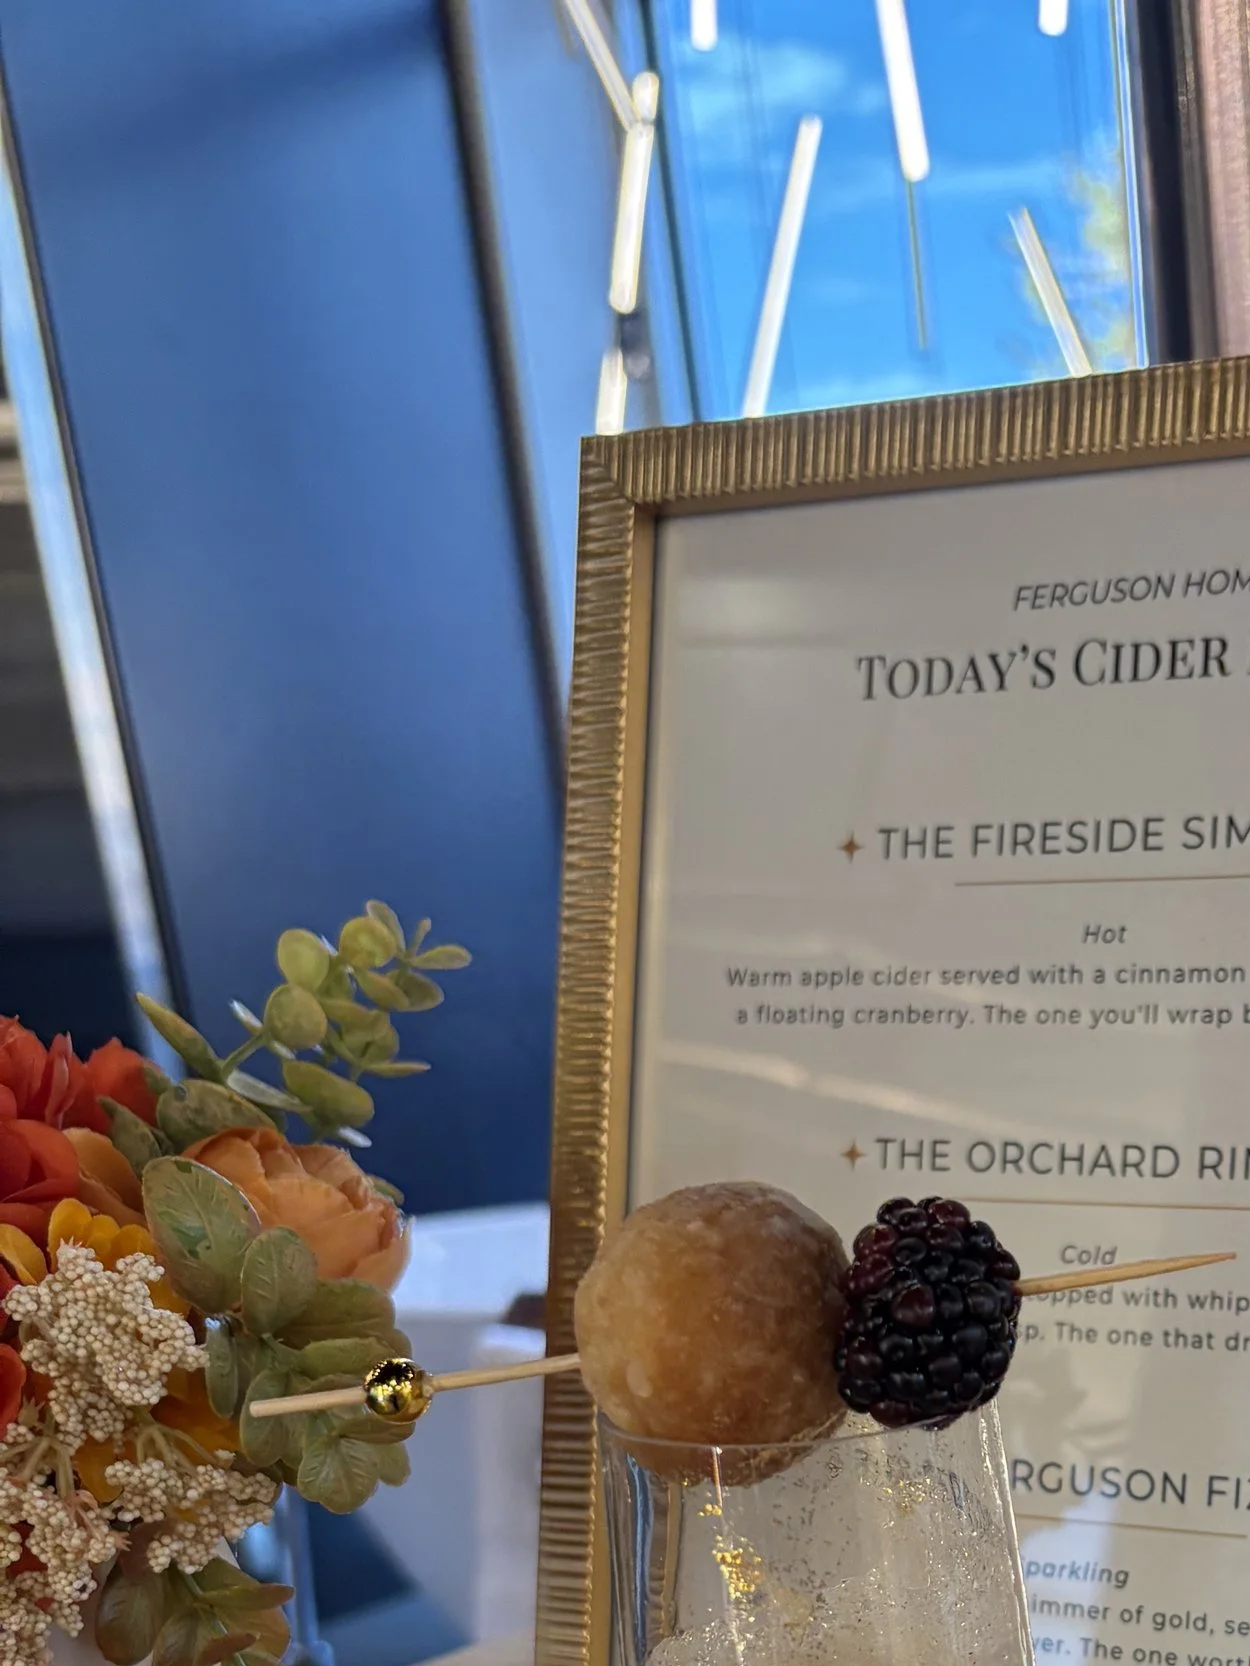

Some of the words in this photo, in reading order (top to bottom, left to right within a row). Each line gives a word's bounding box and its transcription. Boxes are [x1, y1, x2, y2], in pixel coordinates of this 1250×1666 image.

[1013, 573, 1177, 611] FERGUSON
[878, 826, 955, 860] THE
[971, 817, 1165, 857] FIRESIDE
[1082, 924, 1127, 945] Hot
[727, 967, 792, 987] Warm
[801, 966, 863, 990] apple
[872, 965, 930, 986] cider
[939, 964, 1020, 986] served
[1029, 963, 1083, 985] with
[1092, 968, 1106, 984] a
[1115, 963, 1245, 984] cinnamon
[736, 1010, 748, 1025] a
[756, 1004, 844, 1028] floating
[854, 1004, 975, 1029] cranberry.
[984, 1004, 1026, 1025] The
[1035, 1009, 1081, 1025] one
[1089, 1003, 1158, 1029] you'll
[1166, 1008, 1233, 1029] wrap
[875, 1138, 951, 1172] THE
[964, 1141, 1180, 1178] ORCHARD
[1060, 1245, 1118, 1265] Cold
[1026, 1285, 1114, 1307] opped
[1122, 1287, 1178, 1309] with
[1055, 1322, 1099, 1343] The
[1107, 1330, 1153, 1346] one
[1162, 1328, 1214, 1351] that
[1011, 1458, 1187, 1505] RGUSON
[1021, 1558, 1130, 1589] parkling
[1119, 1605, 1145, 1625] of
[1151, 1610, 1215, 1637] gold,
[1079, 1636, 1124, 1660] The
